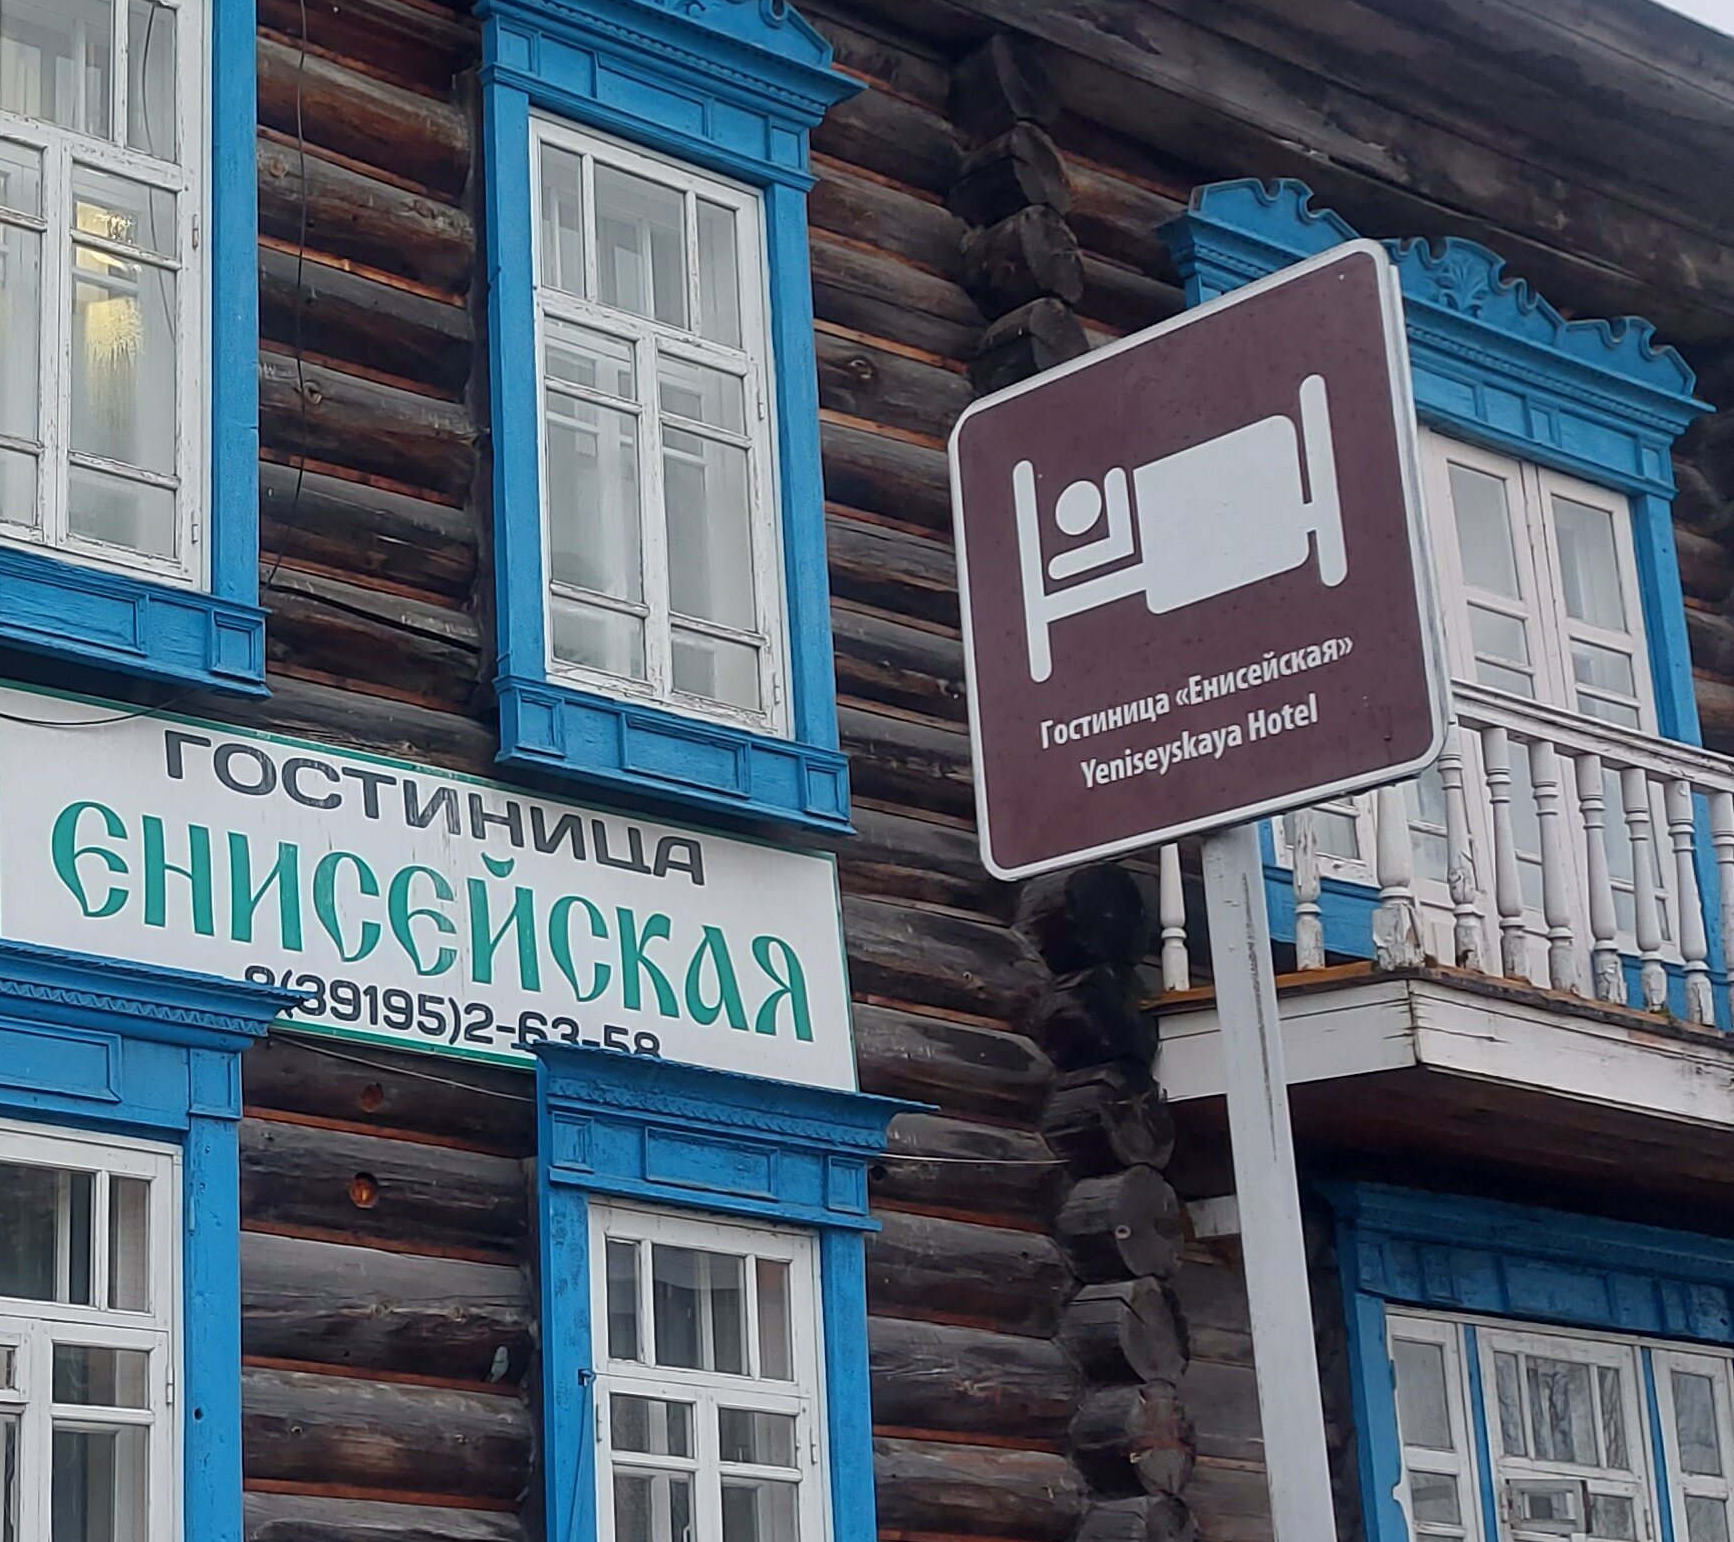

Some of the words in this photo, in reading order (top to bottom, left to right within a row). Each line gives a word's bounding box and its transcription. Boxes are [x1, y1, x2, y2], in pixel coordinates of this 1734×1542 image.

[1040, 692, 1170, 749] Гостиница
[1174, 636, 1353, 706] «Енисейская»
[1080, 730, 1242, 788] Yeniseyskaya
[1247, 693, 1319, 741] Hotel
[164, 730, 705, 887] ГОСТИНИЦА
[51, 800, 815, 1043] ЕНИСЕЙСКАЯ
